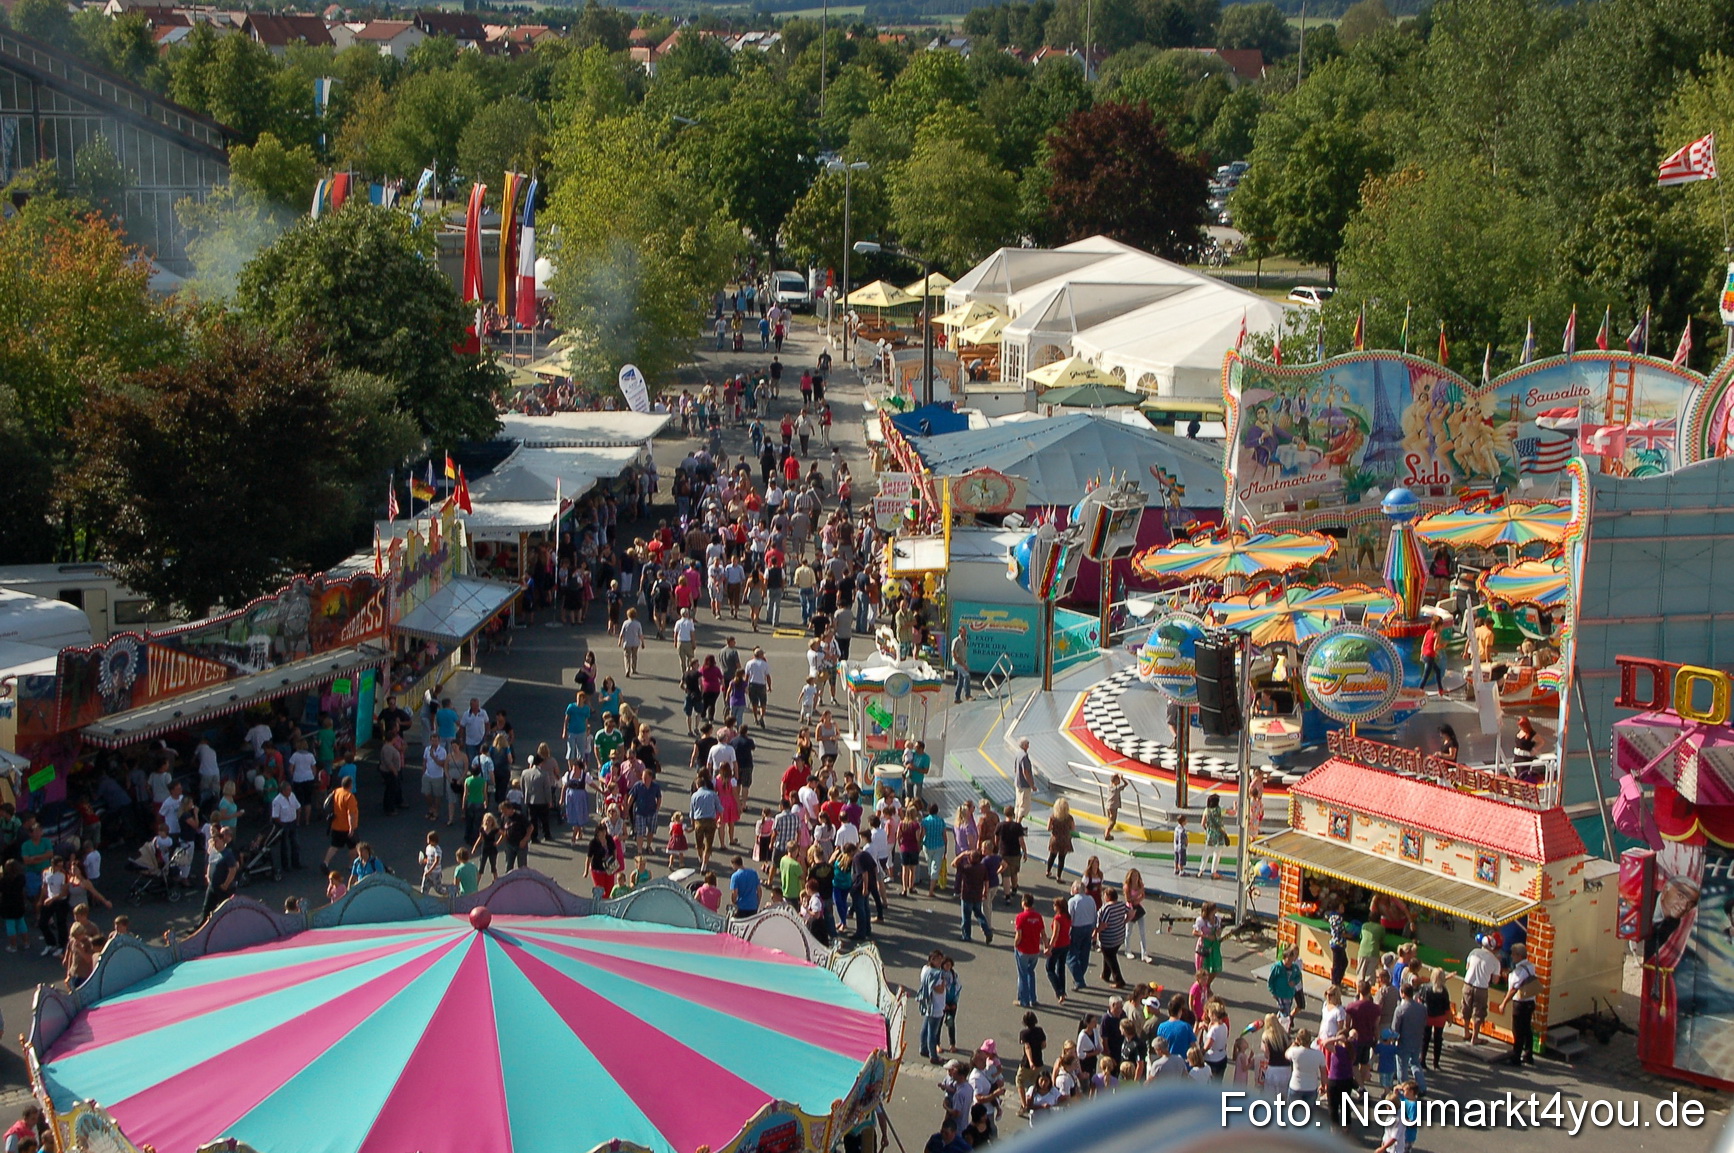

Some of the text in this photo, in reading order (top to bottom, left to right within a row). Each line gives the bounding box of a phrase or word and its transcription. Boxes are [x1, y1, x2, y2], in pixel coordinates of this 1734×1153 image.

[1525, 384, 1591, 407] Sausalito
[1403, 453, 1450, 486] Lido
[1239, 472, 1328, 500] Montmartre
[341, 585, 386, 642] EXPRESS
